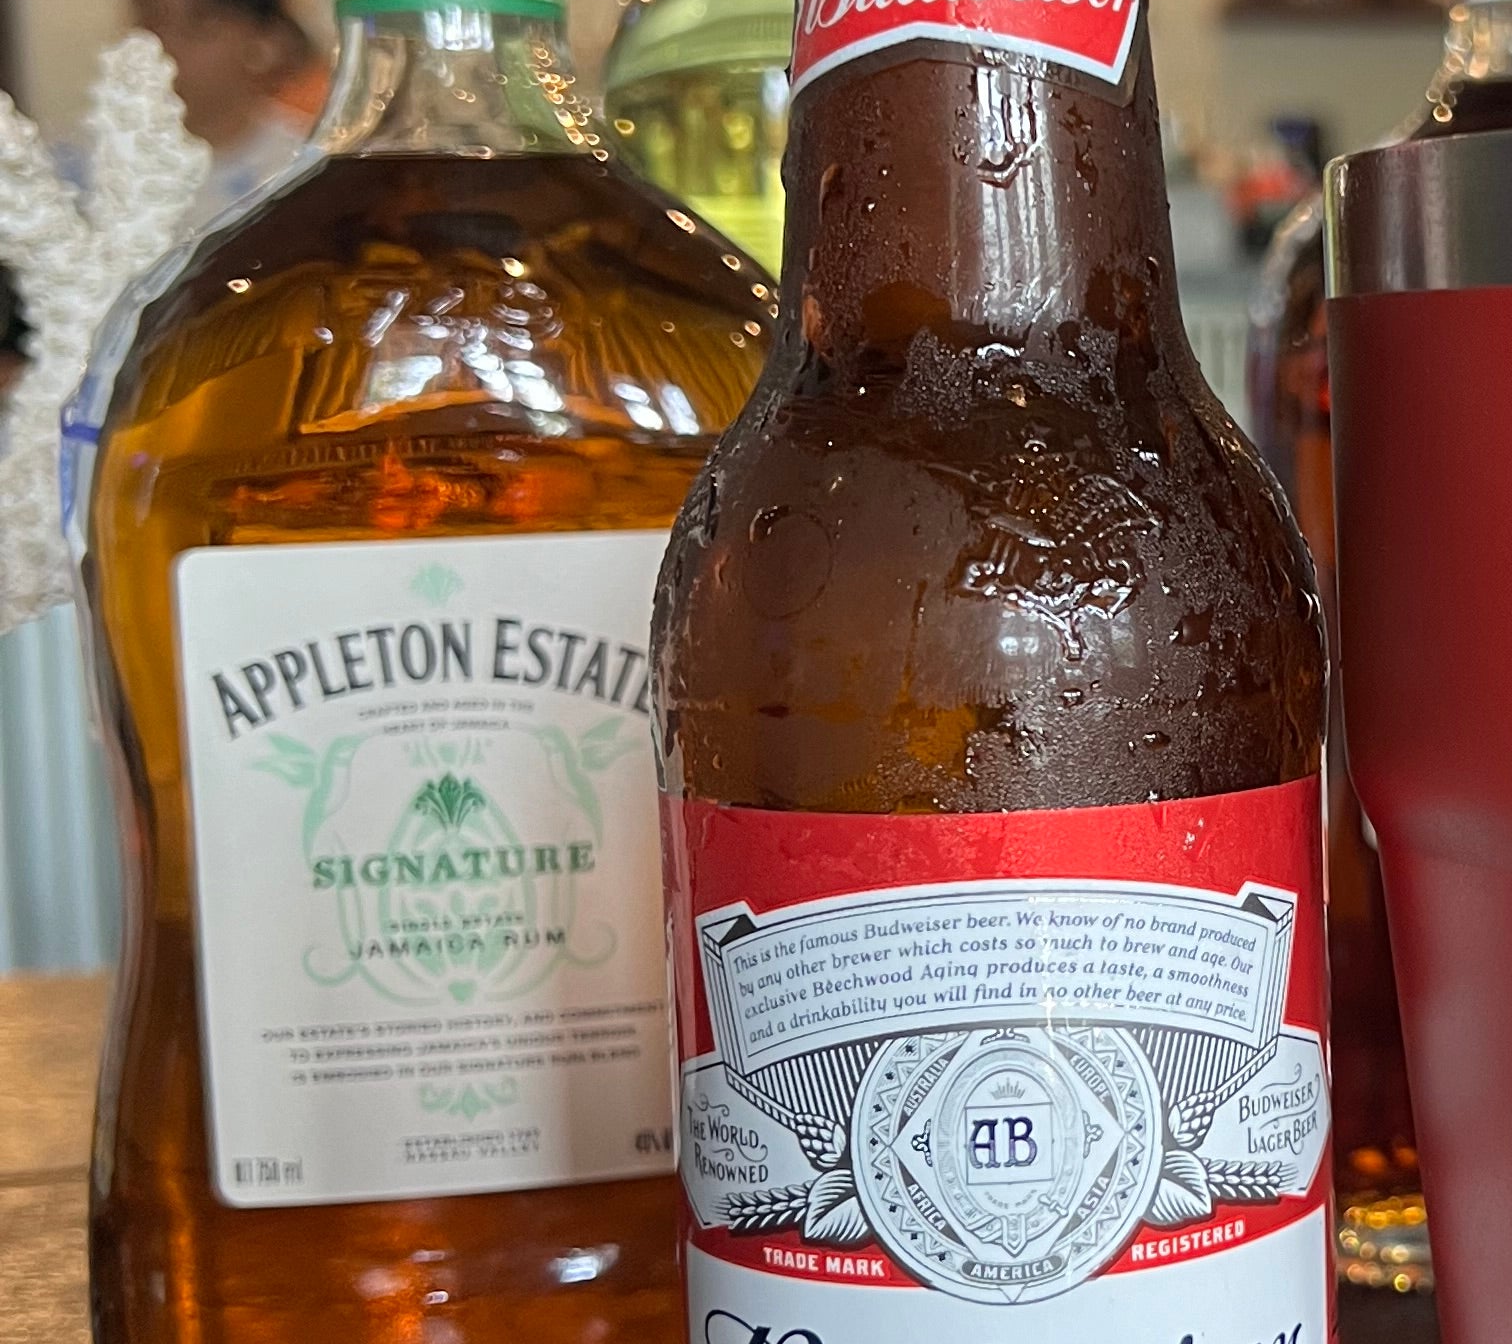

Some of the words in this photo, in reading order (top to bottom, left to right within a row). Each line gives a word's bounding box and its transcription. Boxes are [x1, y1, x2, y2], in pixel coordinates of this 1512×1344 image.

[210, 619, 473, 742] APPLETON
[312, 841, 595, 890] SIGNATURE
[349, 932, 485, 961] JAMAICA
[733, 955, 758, 974] This
[760, 948, 771, 962] is
[774, 940, 796, 957] the
[799, 929, 858, 955] famous
[863, 916, 962, 941] Budweiser
[966, 913, 1011, 930] beer.
[1016, 910, 1042, 926] We
[1048, 910, 1098, 928] know
[1102, 912, 1124, 931] of
[1124, 916, 1146, 931] no
[1150, 915, 1197, 937] brand
[1198, 925, 1257, 953] produced
[739, 981, 755, 998] by
[757, 971, 782, 990] any
[786, 958, 826, 980] other
[832, 948, 891, 969] brewer
[899, 937, 952, 957] which
[959, 936, 1008, 954] costs
[1014, 937, 1036, 951] so
[1042, 934, 1092, 951] much
[1100, 935, 1118, 952] to
[1122, 936, 1166, 955] brew
[1168, 941, 1197, 961] and
[1230, 956, 1254, 976] Our
[744, 989, 807, 1019] exclusive
[812, 966, 913, 998] Beechwood
[986, 957, 1077, 978] produces
[1083, 960, 1094, 974] a
[1099, 961, 1148, 981] taste,
[1152, 966, 1163, 980] a
[1167, 968, 1249, 999] smoothness
[750, 1023, 773, 1044] and
[777, 1021, 786, 1035] a
[790, 996, 887, 1030] drinkability
[893, 992, 927, 1010] you
[933, 985, 967, 1003] will
[973, 981, 1012, 1004] find
[1019, 981, 1037, 998] in
[1043, 985, 1068, 1000] no
[1073, 982, 1121, 1001] other
[1125, 984, 1162, 1004] beer
[1165, 992, 1182, 1006] at
[1185, 993, 1213, 1014] any
[1214, 1000, 1247, 1023] price.
[903, 1056, 949, 1116] AUSTRALIA
[1070, 1055, 1110, 1103] EUROPE
[1239, 1079, 1316, 1124] BUDWEISER
[687, 1105, 705, 1141] THE
[707, 1115, 764, 1156] WORLD
[969, 1117, 1038, 1169] AB
[693, 1143, 769, 1185] RENOWNED
[907, 1183, 948, 1232] AFRICA
[1077, 1175, 1110, 1221] ASIA
[762, 1246, 819, 1272] TRADE
[825, 1256, 885, 1278] MARK
[1131, 1220, 1245, 1262] REGISTERED
[970, 1258, 1053, 1281] AMERICA
